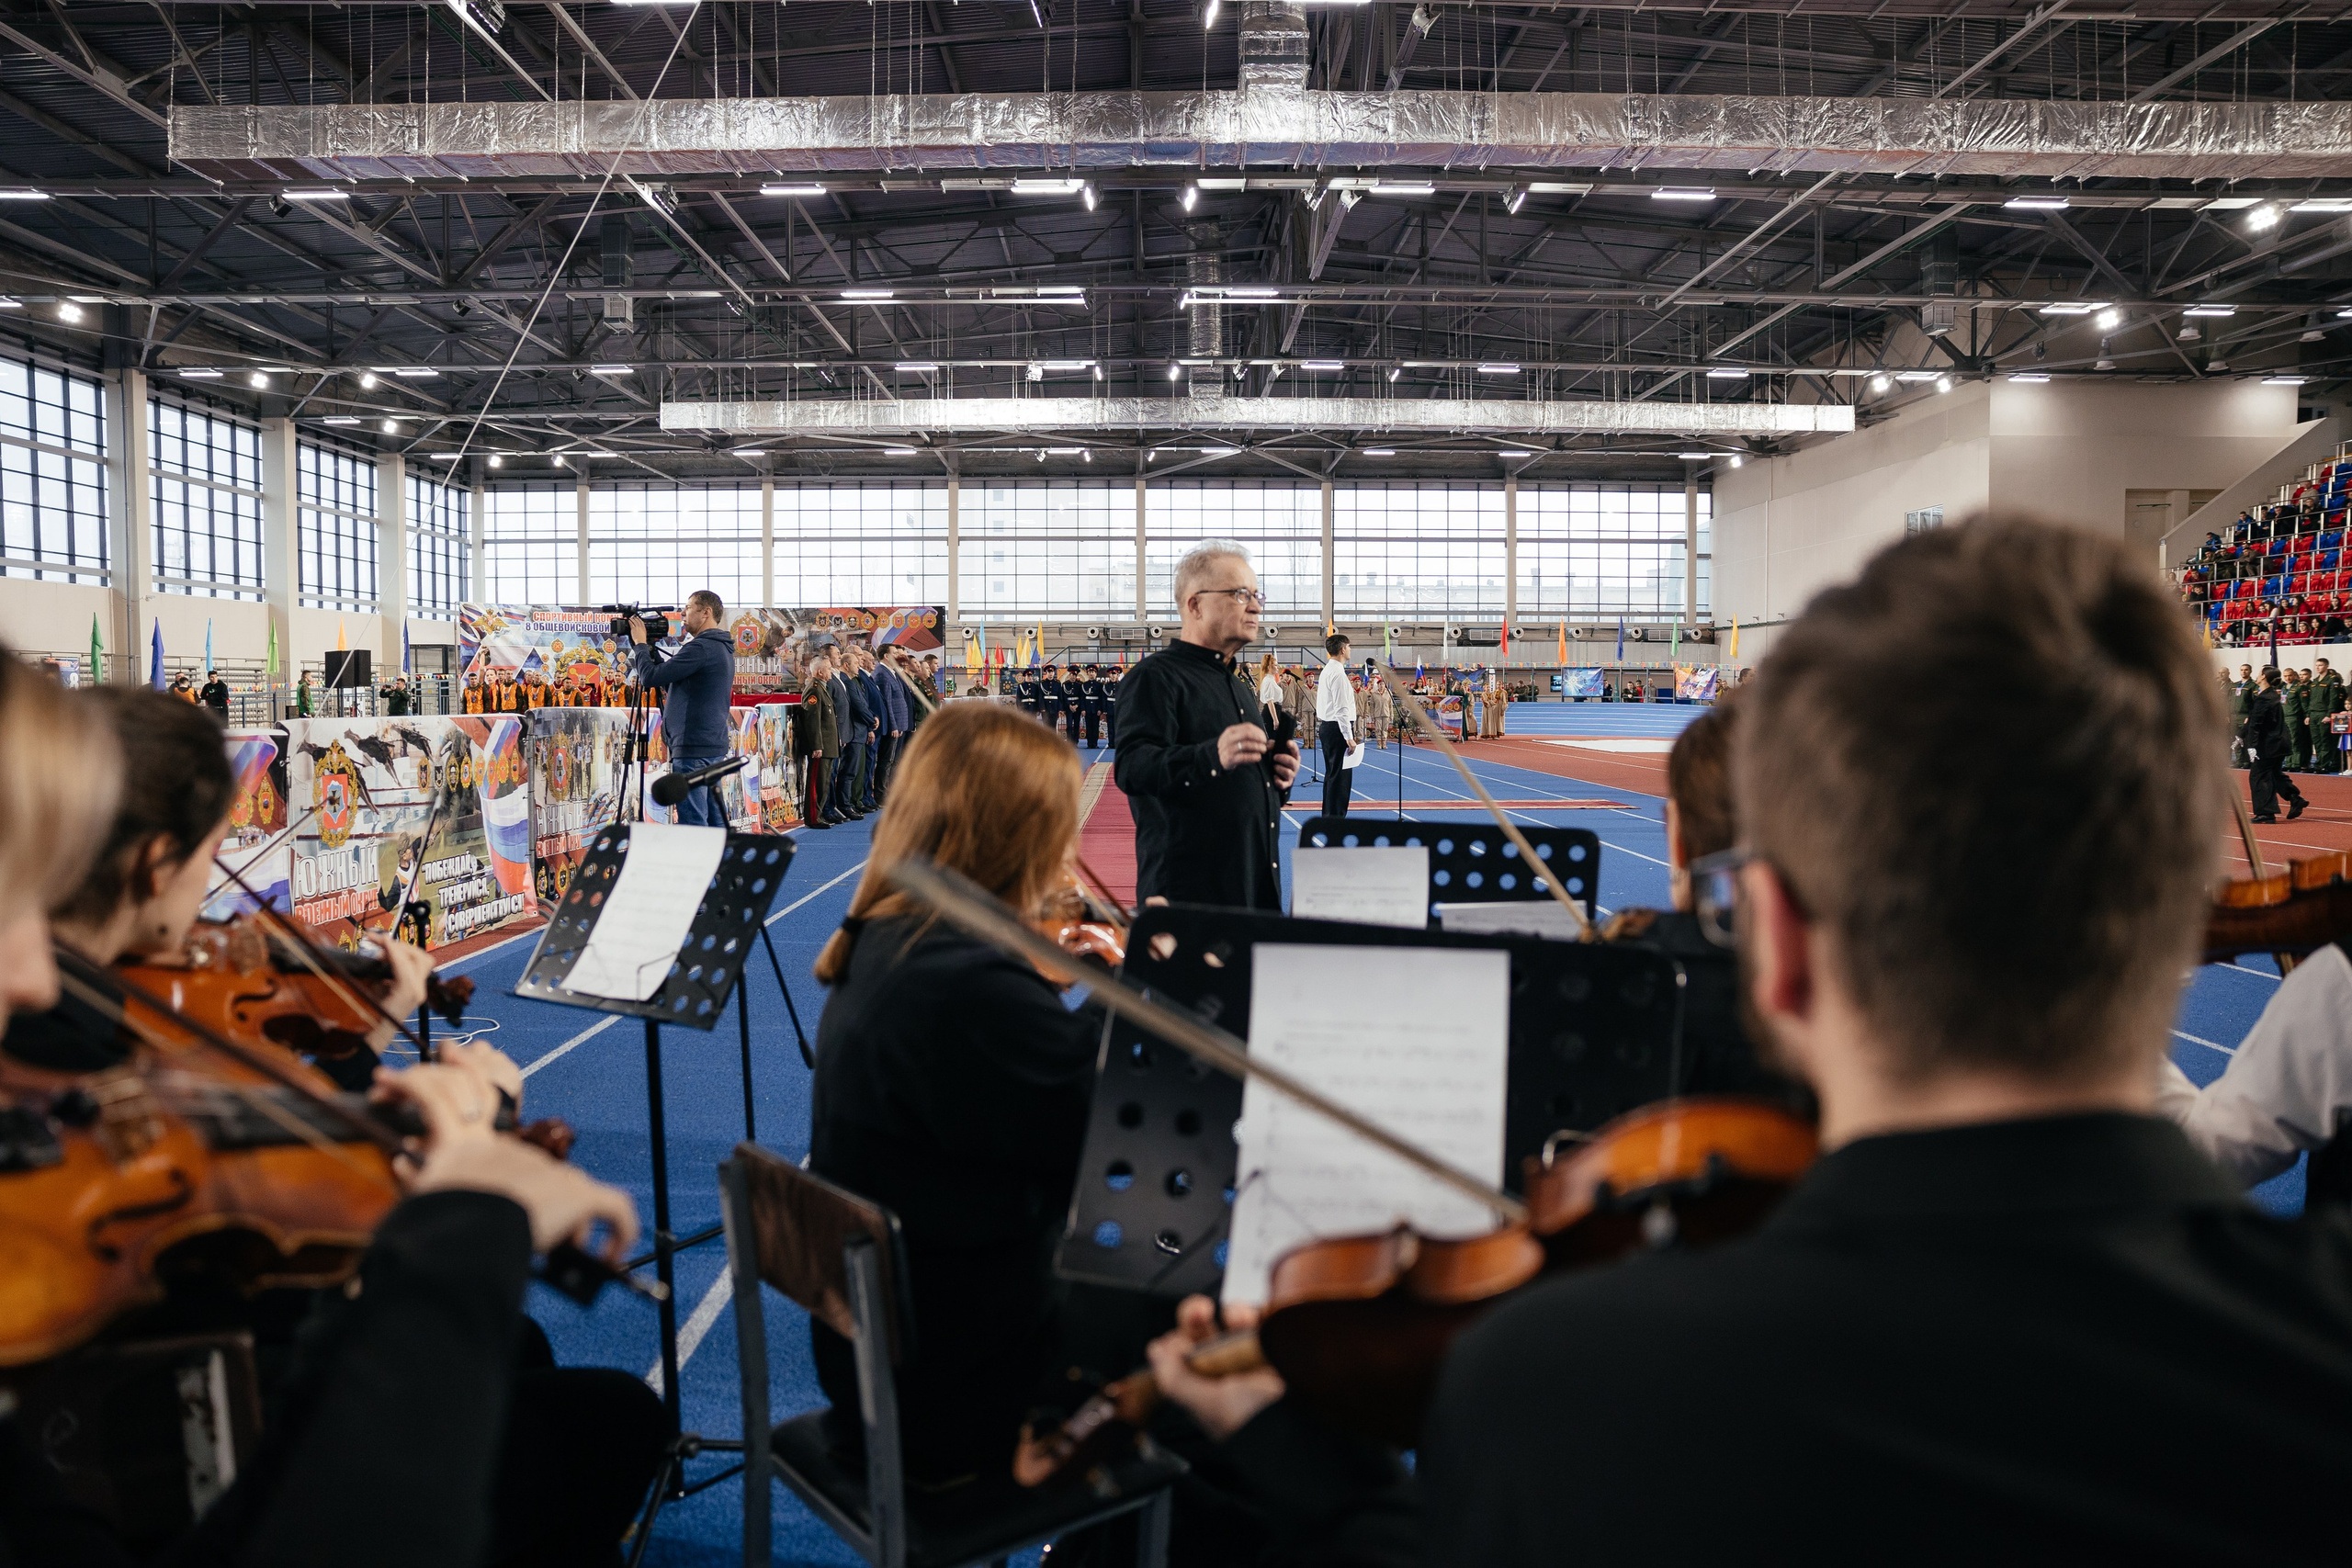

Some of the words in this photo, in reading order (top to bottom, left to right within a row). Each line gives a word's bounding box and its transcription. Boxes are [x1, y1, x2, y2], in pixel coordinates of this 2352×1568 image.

[533, 611, 594, 623] СПОРТИВНЫЙ
[526, 623, 531, 631] 8
[734, 653, 783, 673] ЖНЫЙ
[758, 675, 782, 685] ОКРУГ
[294, 836, 379, 900] ЮЖНЫЙ
[350, 888, 379, 916] ОКРУГ
